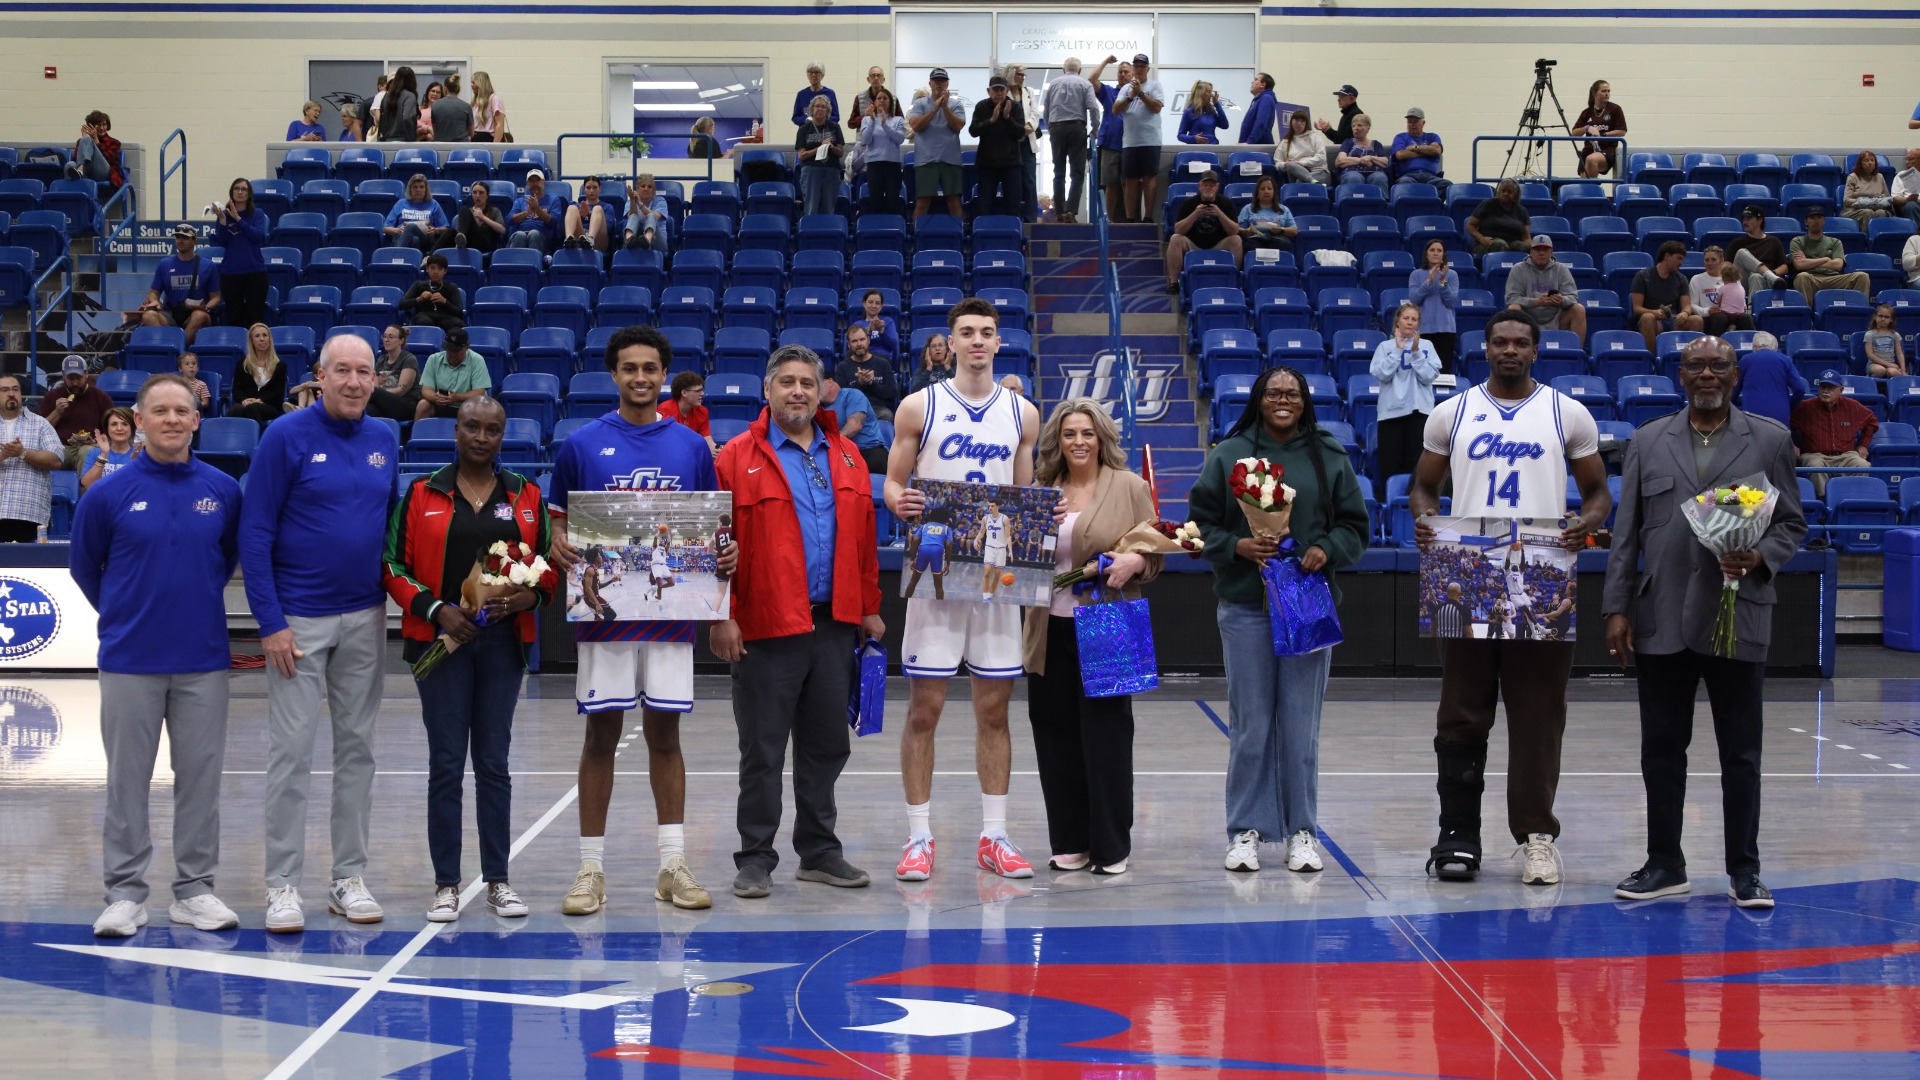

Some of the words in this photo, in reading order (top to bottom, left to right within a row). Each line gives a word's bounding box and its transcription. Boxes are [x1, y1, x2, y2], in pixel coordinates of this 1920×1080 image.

[1098, 40, 1138, 50] ROOM
[938, 432, 1011, 467] Chaps
[1467, 432, 1545, 466] Chaps
[1486, 469, 1520, 508] 14
[718, 532, 732, 547] 21
[927, 525, 942, 535] 20
[5, 600, 51, 618] STAR
[5, 634, 44, 654] SYSTEMS
